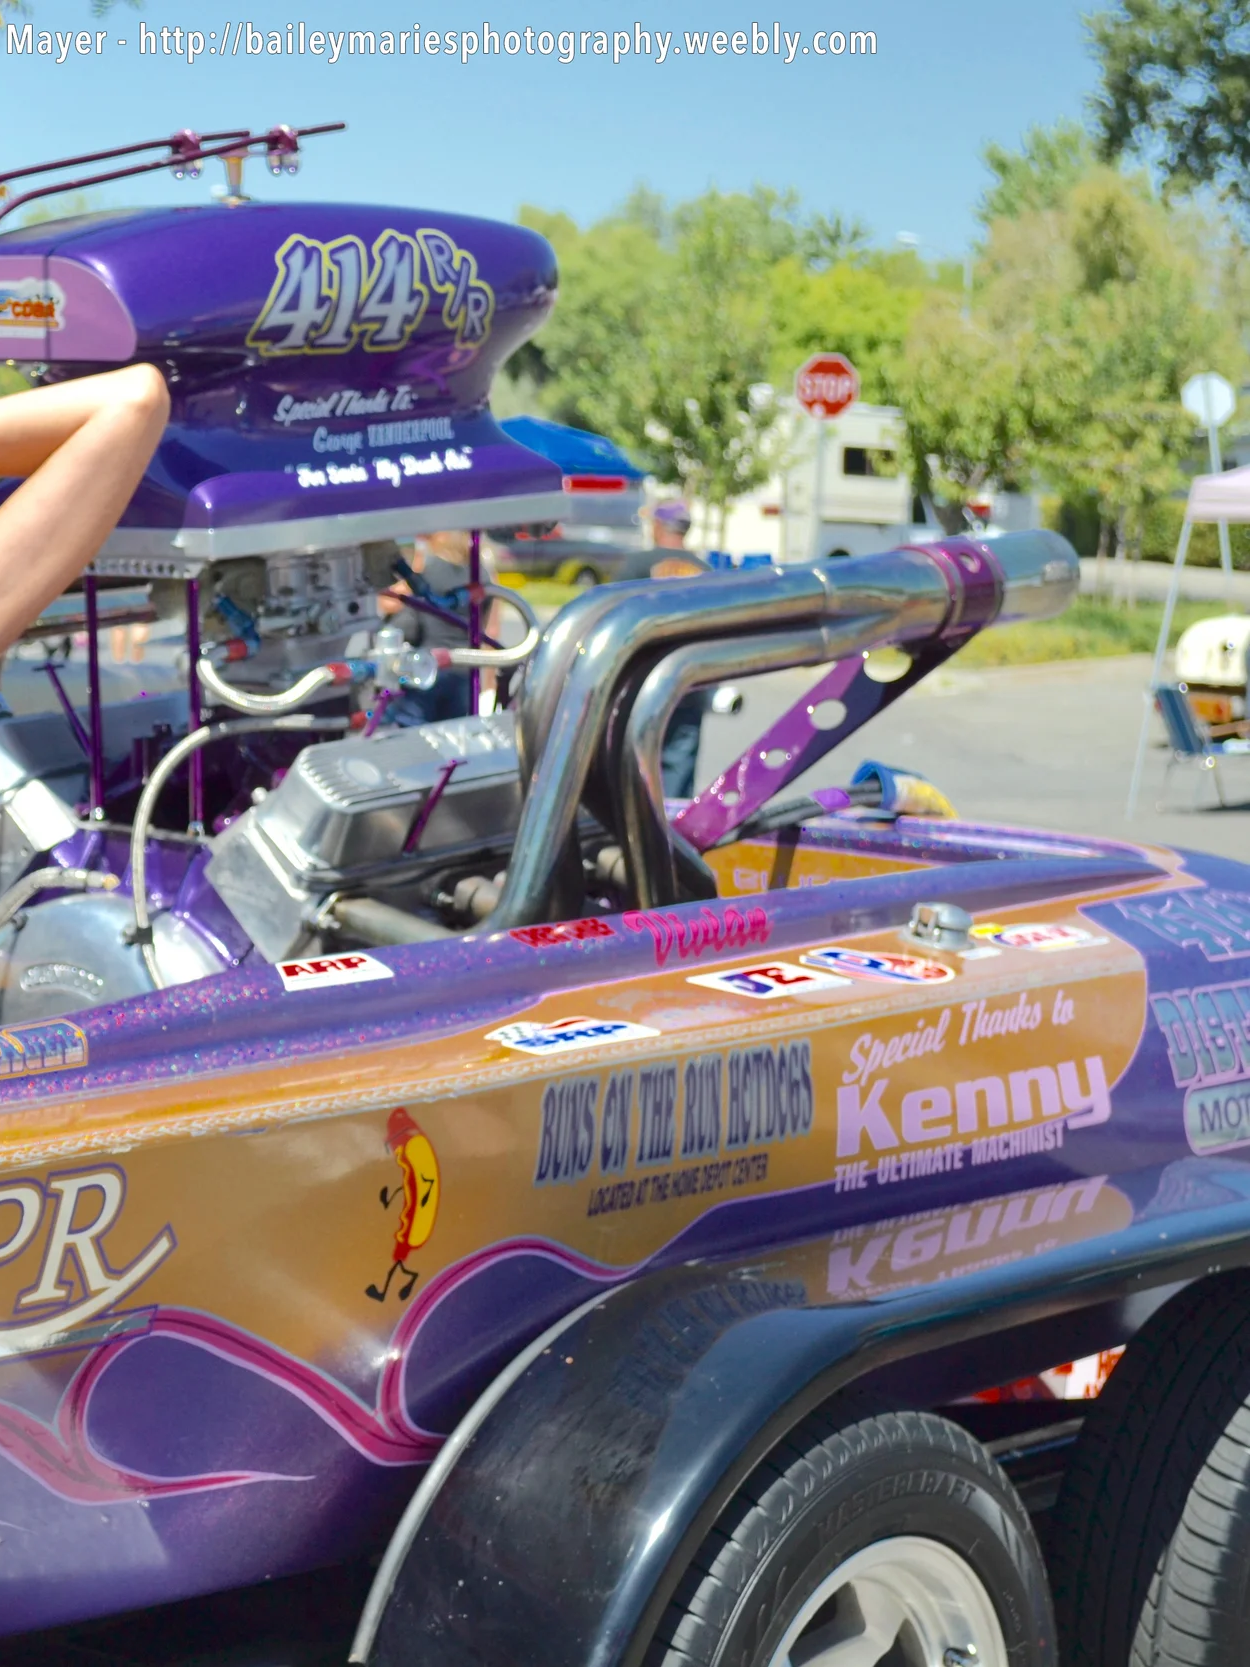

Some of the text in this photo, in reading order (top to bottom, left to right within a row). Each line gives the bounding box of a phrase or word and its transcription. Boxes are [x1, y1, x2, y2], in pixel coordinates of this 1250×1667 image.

[253, 236, 425, 352] 414
[274, 392, 340, 427] Special
[335, 388, 390, 416] Thanks
[801, 373, 853, 403] STOP
[313, 426, 364, 455] George
[282, 956, 367, 977] ARP
[842, 989, 1074, 1086] Special Thanks to
[536, 1039, 812, 1182] BUNS ON THE RUN HOTDOGS
[836, 1055, 1111, 1158] Kenny
[587, 1153, 769, 1217] LOCATED AT THE HOME DEPOT CENTER
[834, 1120, 1068, 1194] THE ULTIMATE MACHINIST
